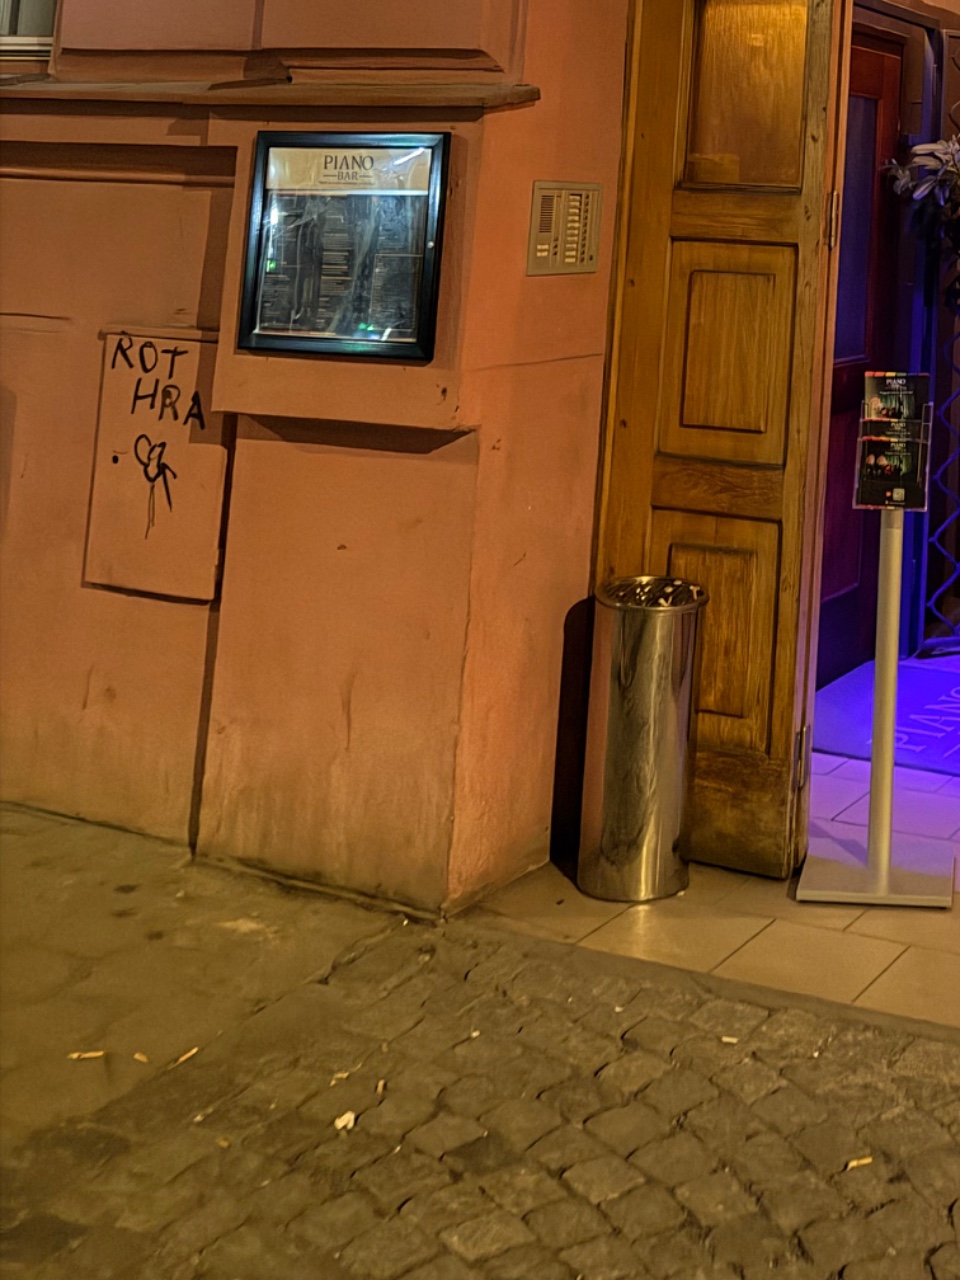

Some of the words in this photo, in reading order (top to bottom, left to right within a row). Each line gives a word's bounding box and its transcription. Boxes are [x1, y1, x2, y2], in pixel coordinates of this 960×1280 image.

[323, 155, 374, 170] PIANO
[338, 171, 358, 180] BAR
[112, 331, 188, 380] ROT
[131, 377, 205, 430] HRA
